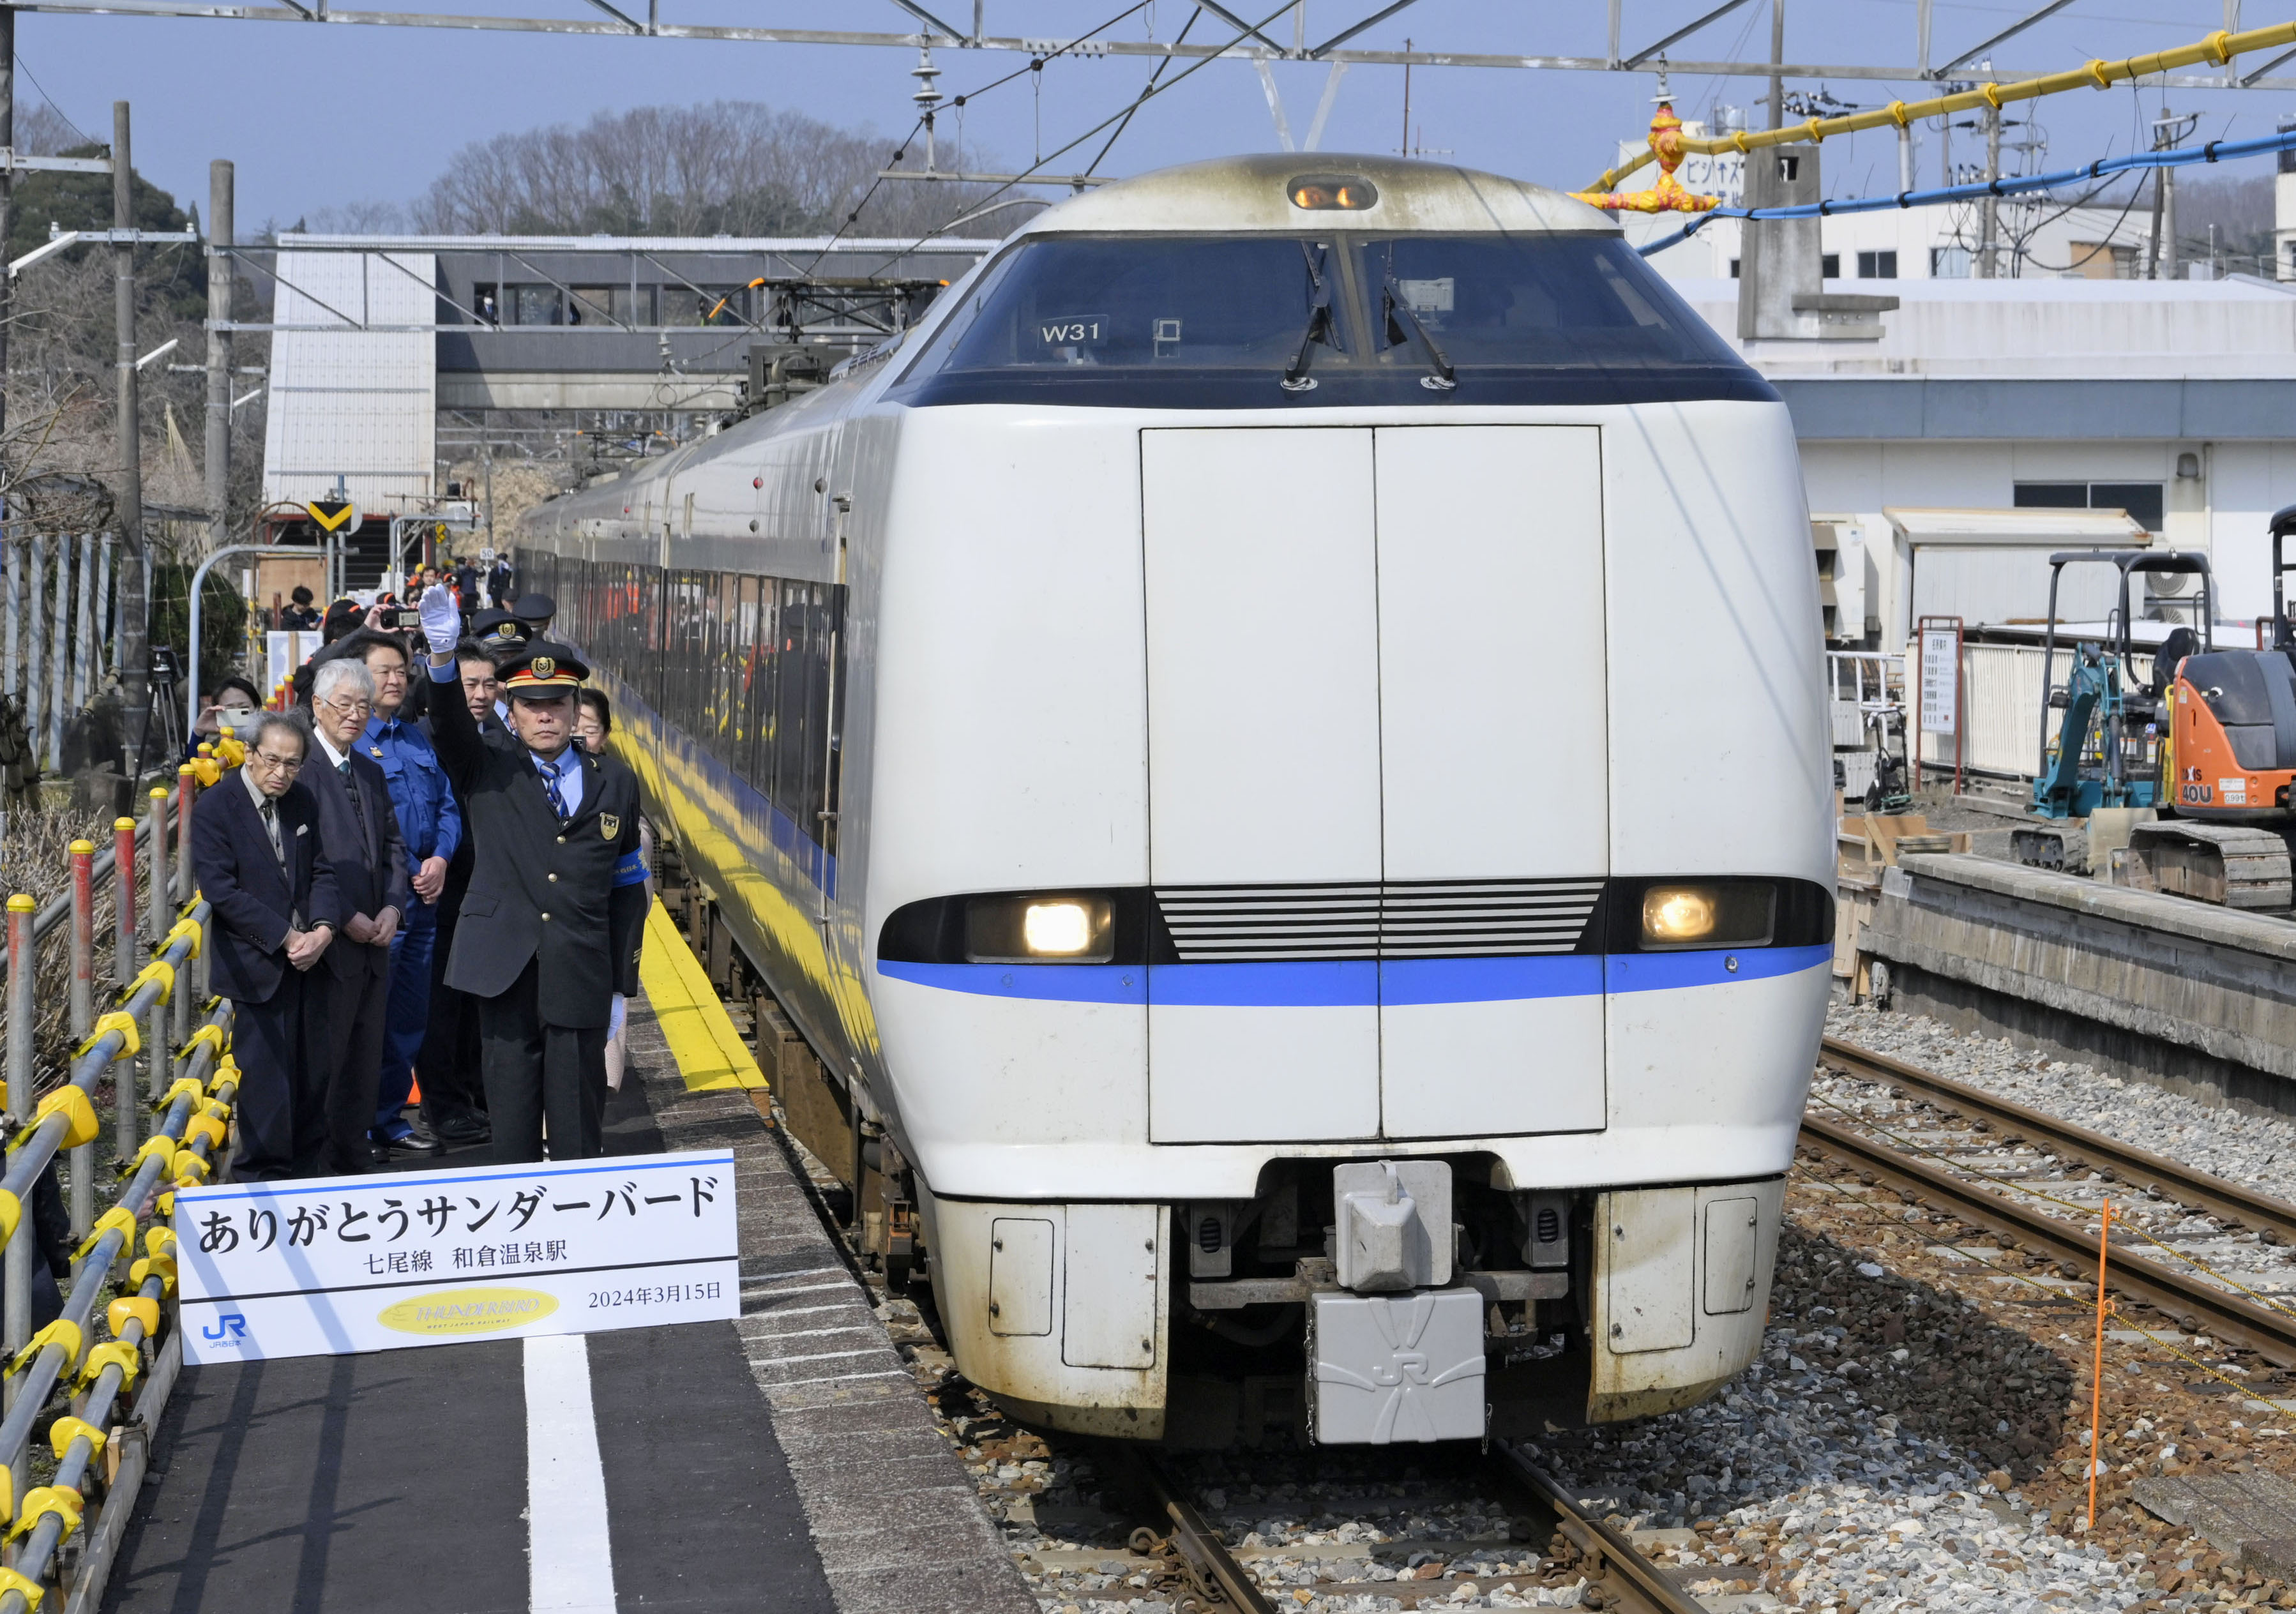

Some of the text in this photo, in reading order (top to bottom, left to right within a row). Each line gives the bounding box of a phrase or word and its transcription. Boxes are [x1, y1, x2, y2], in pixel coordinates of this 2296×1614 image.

[1042, 323, 1099, 342] W31
[199, 1176, 718, 1255] ありがとうサンダーバード
[363, 1239, 568, 1275] 七尾線 和倉温泉駅
[589, 1281, 720, 1308] 2024年3月15日
[416, 1298, 540, 1320] THUNDERBIRD
[202, 1314, 246, 1339] JR
[209, 1340, 242, 1348] JR西日本
[1373, 1353, 1430, 1386] JR
